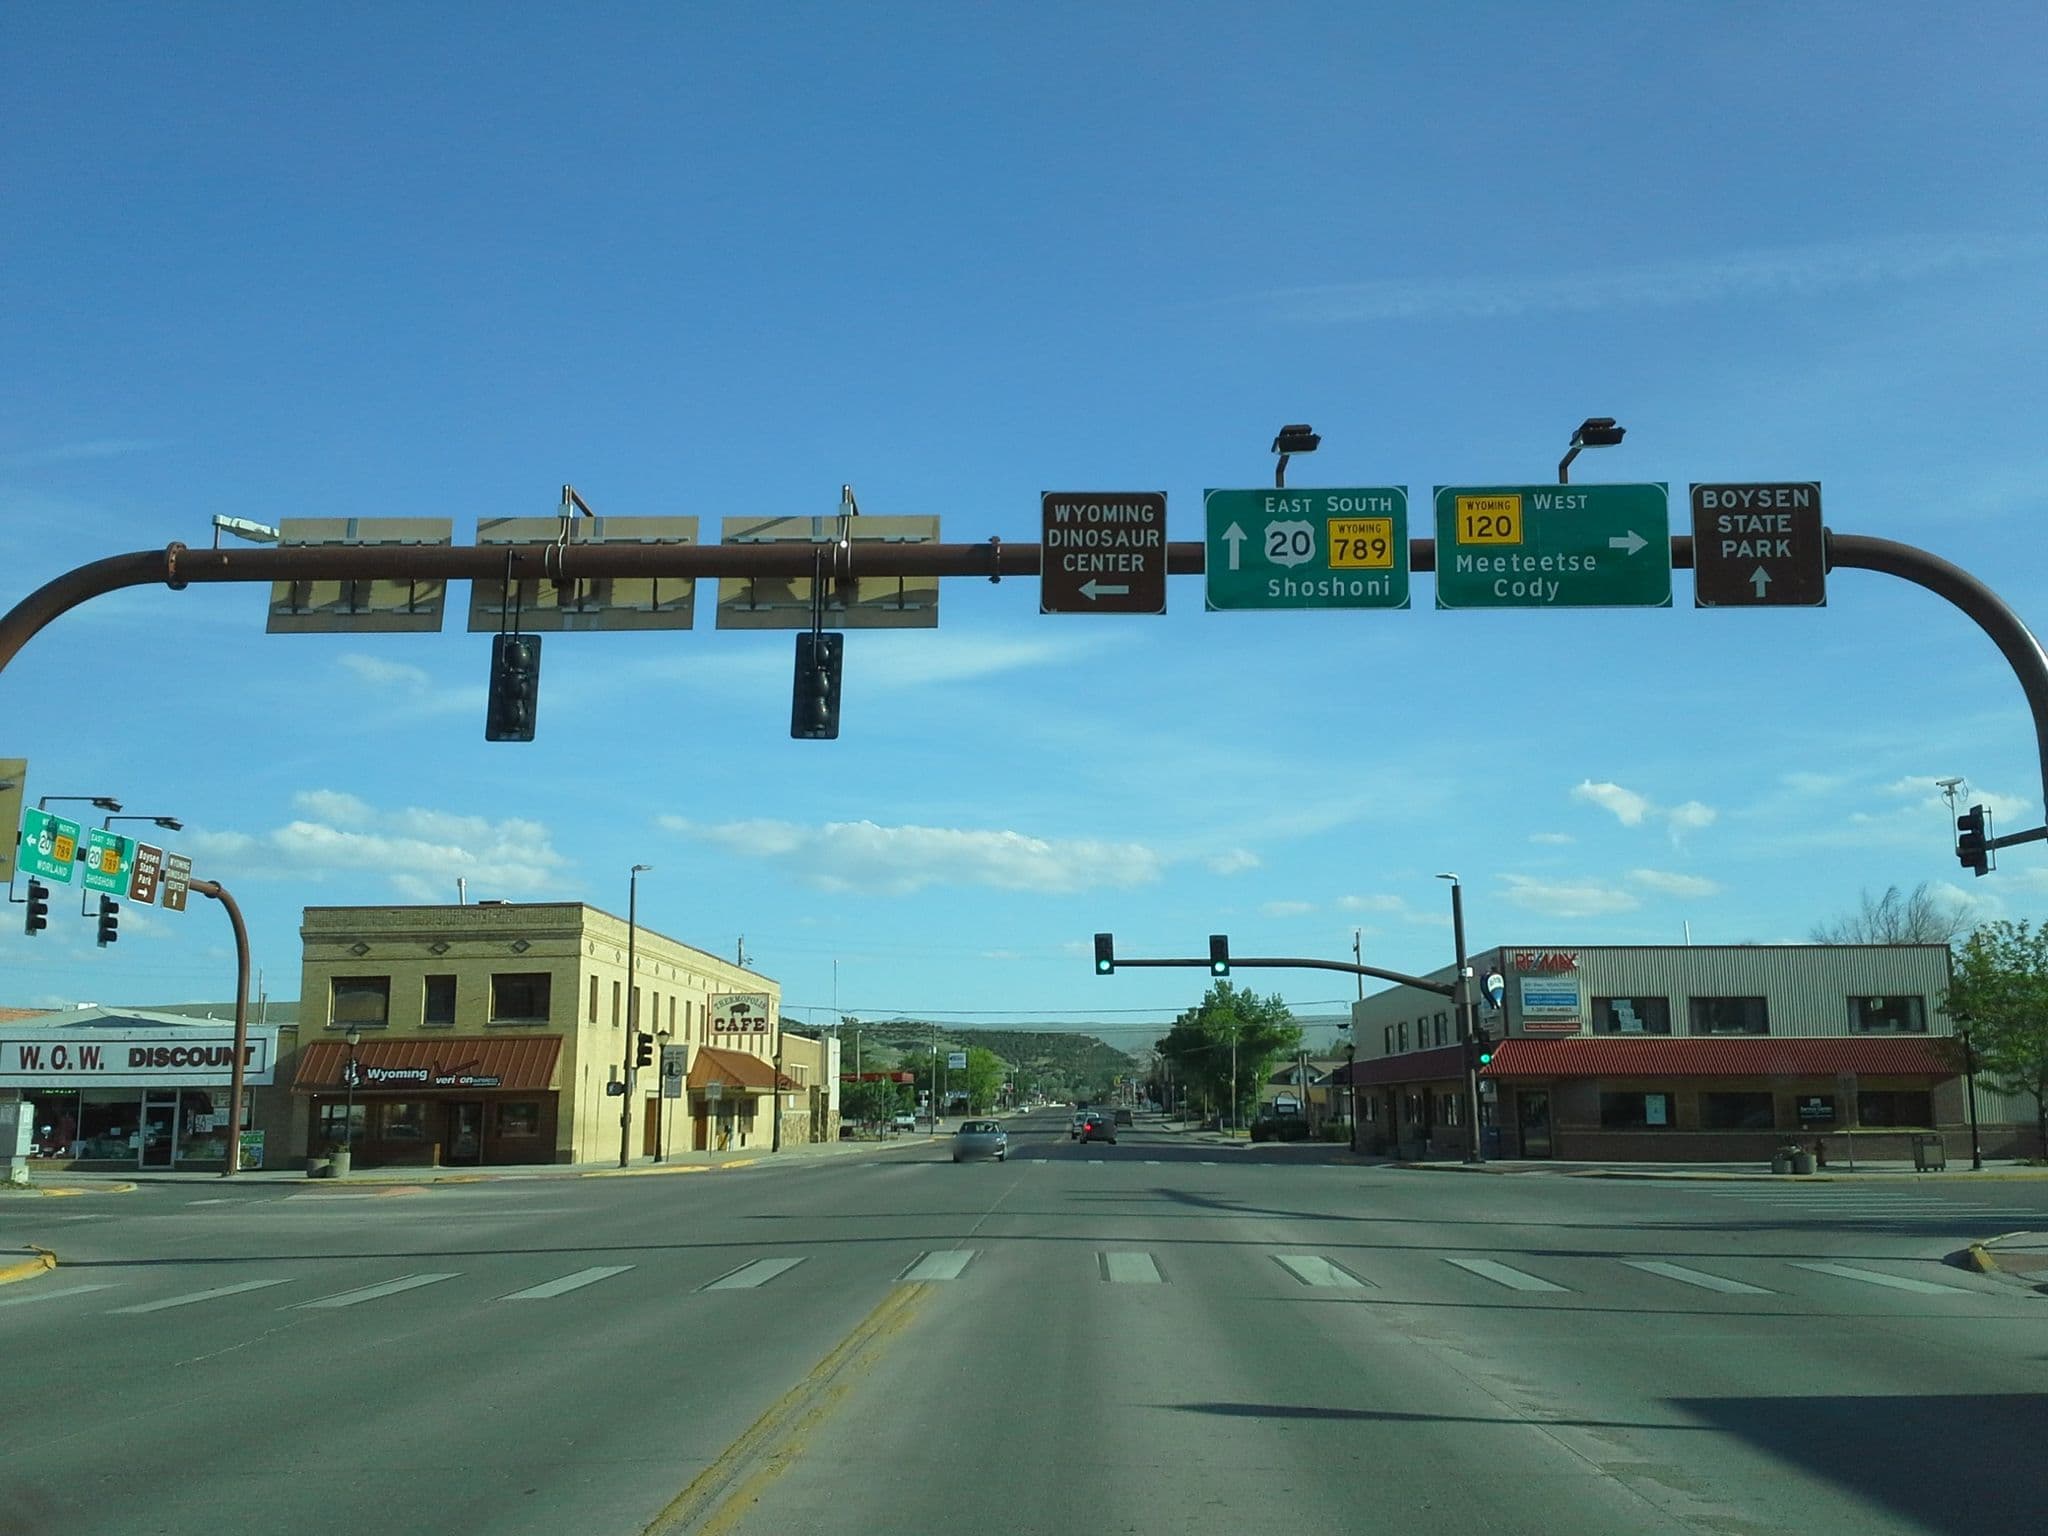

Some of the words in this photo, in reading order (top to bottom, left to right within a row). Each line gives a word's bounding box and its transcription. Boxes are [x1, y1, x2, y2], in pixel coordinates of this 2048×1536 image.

[1265, 497, 1312, 513] EAST
[1327, 496, 1392, 512] SOUTH
[1466, 500, 1511, 511] WYOMING
[1534, 494, 1587, 510] WEST
[1702, 489, 1810, 509] BOYSEN
[1055, 505, 1154, 523] WYOMING
[1338, 523, 1382, 534] WYOMING
[1466, 515, 1512, 538] 120
[1717, 514, 1793, 533] STATE
[1049, 529, 1160, 548] DINOSAUR
[1269, 530, 1310, 557] 20
[1334, 539, 1387, 561] 789
[1722, 539, 1792, 558] PARK
[1063, 554, 1145, 572] CENTER
[1456, 553, 1597, 573] Meeteetse
[1268, 574, 1390, 597] Shoshoni
[1494, 577, 1560, 601] Cody
[40, 834, 51, 851] 20
[56, 844, 71, 861] 789
[89, 850, 99, 866] 20
[139, 849, 160, 865] Boysen
[37, 860, 69, 877] WORLAND
[140, 863, 155, 875] State
[138, 873, 153, 886] Park
[714, 995, 767, 1010] THERMOPOLIS
[714, 1017, 765, 1032] CAFE
[20, 1045, 104, 1070] W.O.W.
[128, 1046, 256, 1068] DISCOUNT
[367, 1067, 428, 1082] Wyoming
[436, 1072, 474, 1085] verion
